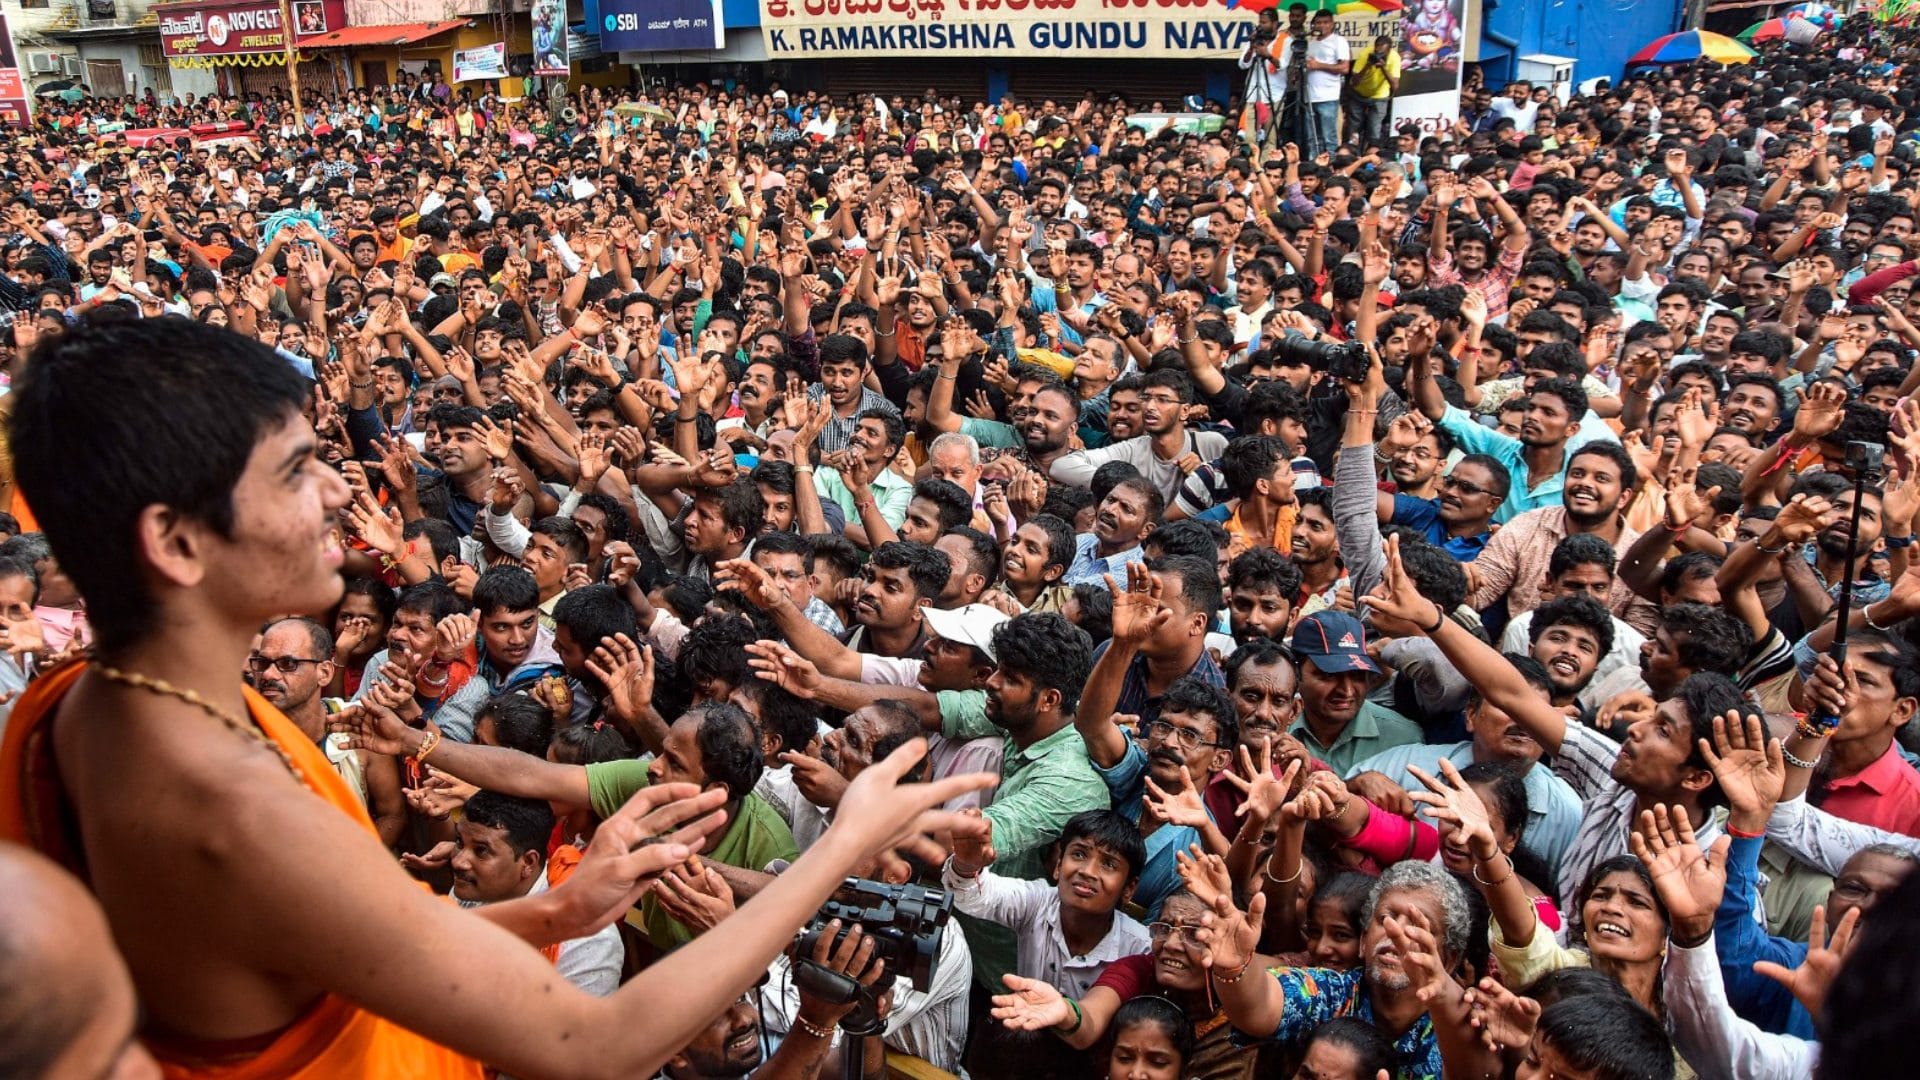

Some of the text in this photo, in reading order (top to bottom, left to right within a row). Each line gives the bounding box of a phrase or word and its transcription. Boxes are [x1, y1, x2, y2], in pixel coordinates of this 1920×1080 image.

[228, 8, 281, 31] NOVELT
[617, 13, 638, 31] SBI
[693, 18, 708, 28] ATM
[771, 21, 1284, 51] K. RAMAKRISHNA GUNDU NAYA
[1367, 21, 1400, 37] MER
